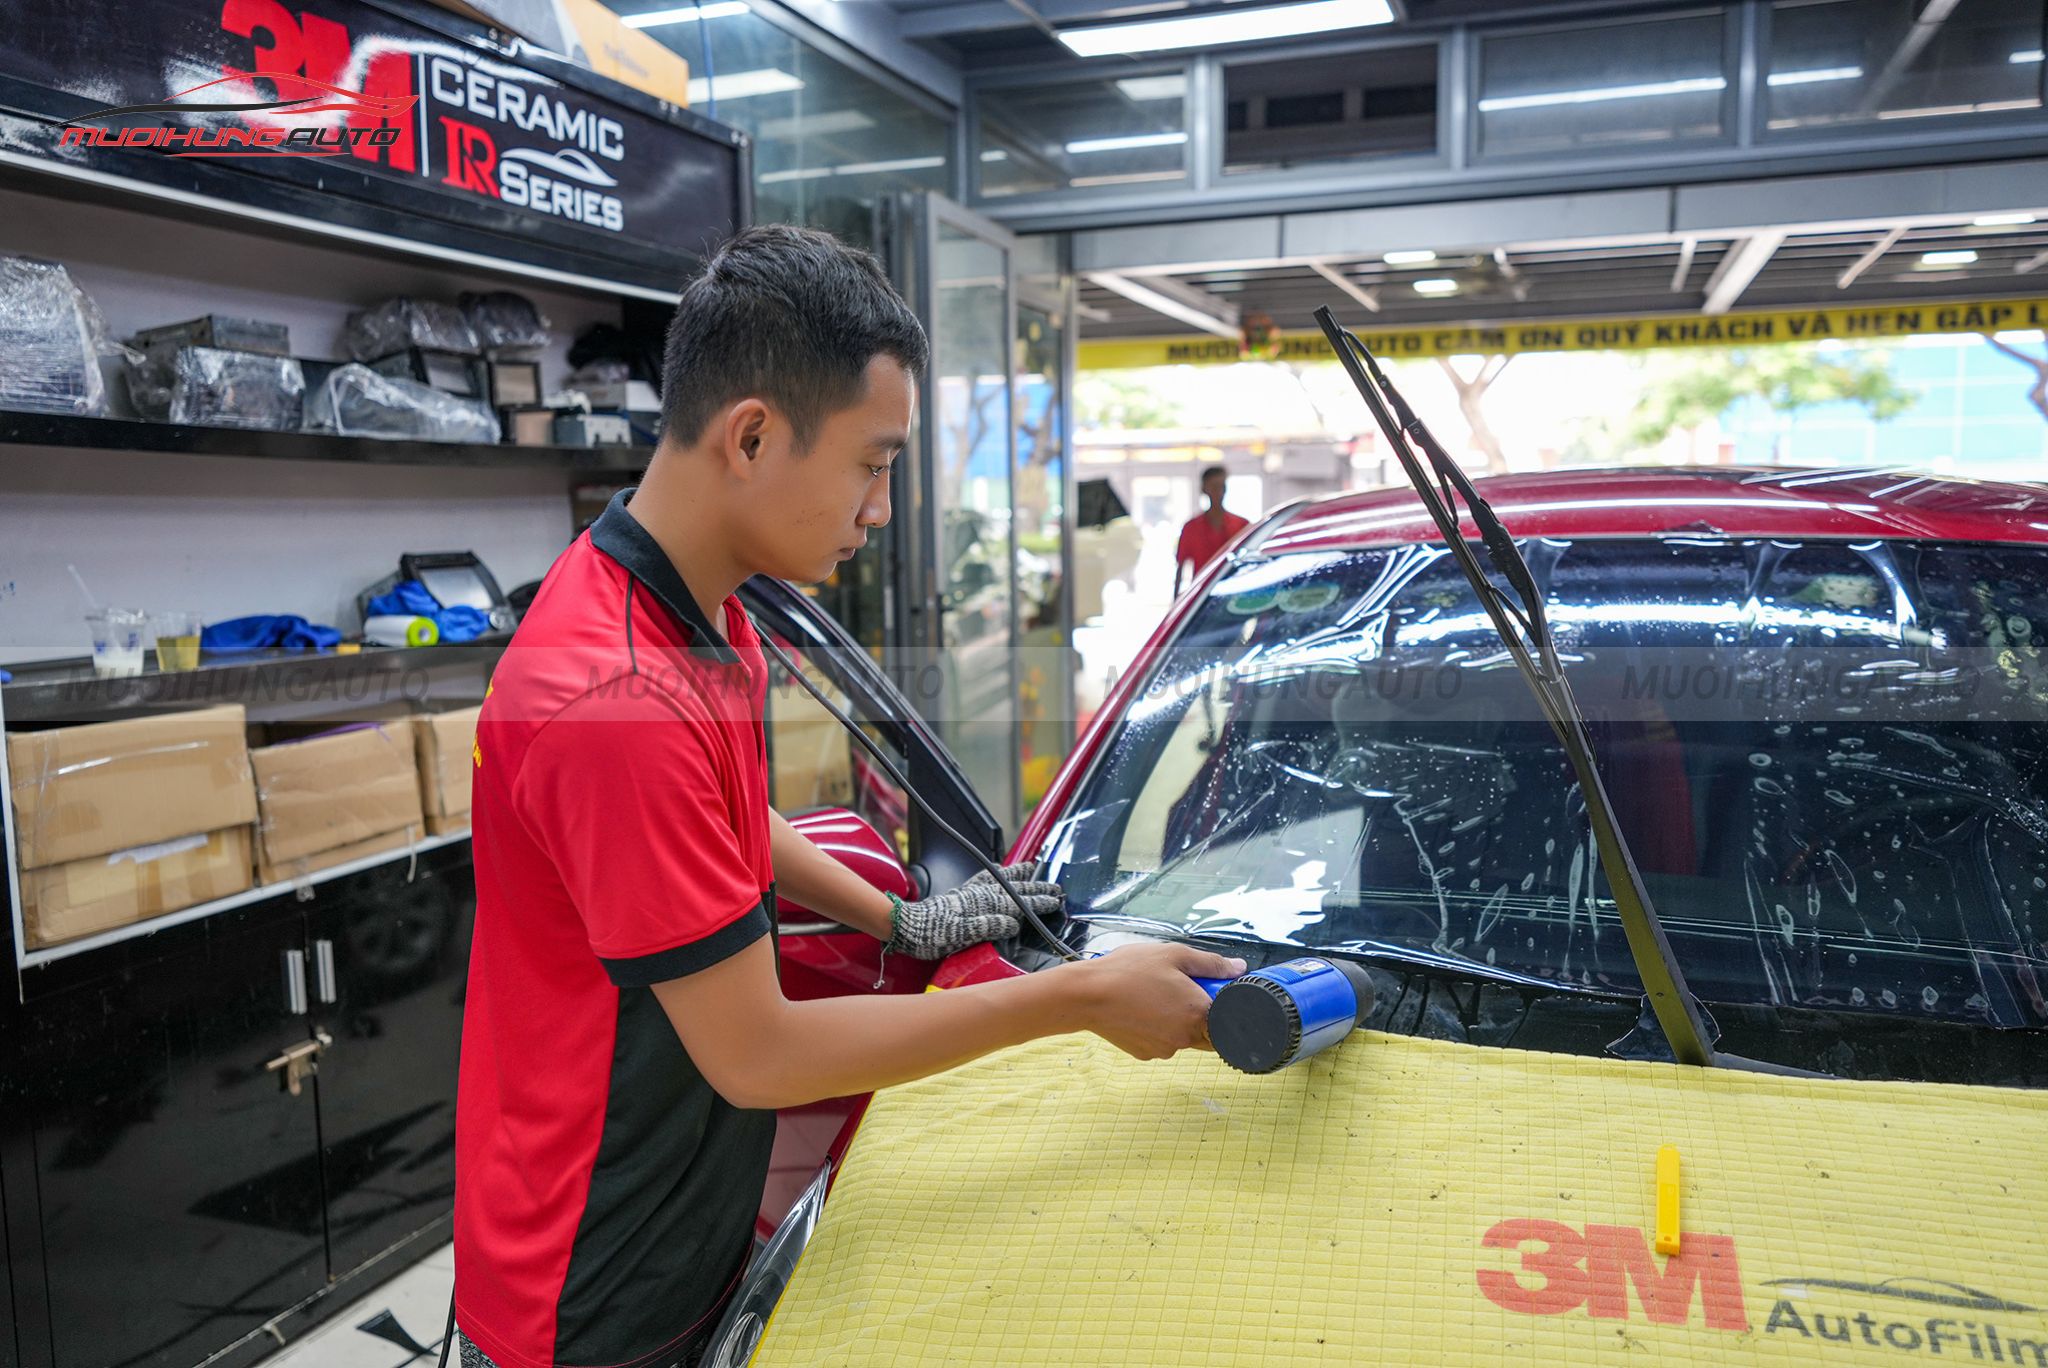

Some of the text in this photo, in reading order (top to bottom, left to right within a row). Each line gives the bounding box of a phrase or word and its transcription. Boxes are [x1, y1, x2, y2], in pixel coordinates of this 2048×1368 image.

[221, 0, 416, 174] 3M
[431, 57, 625, 161] CERAMIC
[499, 159, 624, 232] SERIES
[1476, 1218, 1750, 1334] 3M
